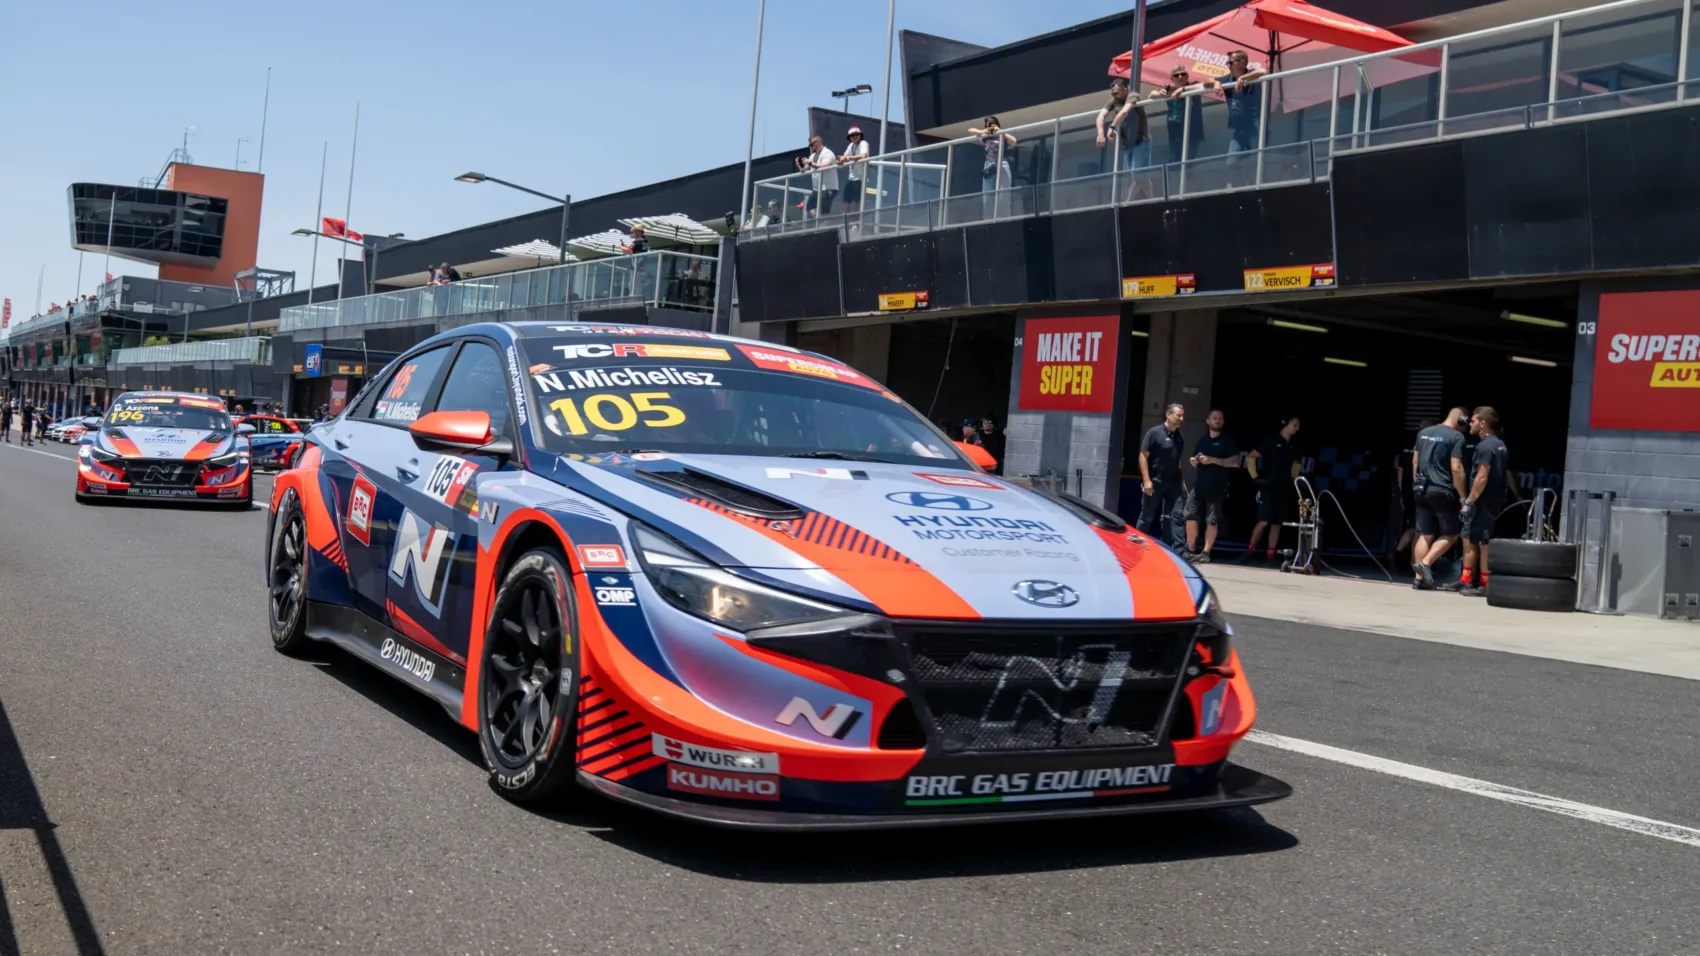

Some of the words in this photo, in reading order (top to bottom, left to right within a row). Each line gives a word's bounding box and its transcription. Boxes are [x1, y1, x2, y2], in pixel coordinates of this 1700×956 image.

[1124, 281, 1139, 296] 179
[1139, 285, 1155, 295] HUFF
[1244, 274, 1263, 289] 122
[1264, 276, 1301, 287] VERVISCH
[1578, 321, 1596, 335] 03
[1014, 337, 1023, 347] 04
[1037, 332, 1082, 362] MAKE
[1085, 331, 1102, 362] IT
[1608, 333, 1700, 363] SUPER
[552, 343, 649, 359] TCR
[534, 367, 723, 393] N.Michelisz
[1040, 364, 1093, 395] SUPER
[111, 411, 144, 424] 196
[549, 392, 687, 436] 105
[427, 457, 461, 497] 105
[158, 488, 197, 496] EQUIPMENT
[353, 496, 368, 518] BRC
[893, 515, 1056, 532] HYUNDAI
[913, 529, 1070, 544] MOTORSPORT
[590, 550, 613, 558] BRC
[941, 546, 1021, 557] Customer
[1024, 548, 1081, 562] Racing
[596, 590, 635, 603] OMP
[392, 643, 436, 682] HYUNDAI
[688, 747, 765, 769] WÜRH
[670, 768, 777, 795] KUMHO
[906, 775, 966, 797] BRC
[971, 773, 1031, 794] GAS
[1034, 763, 1176, 791] EQUIPMENT
